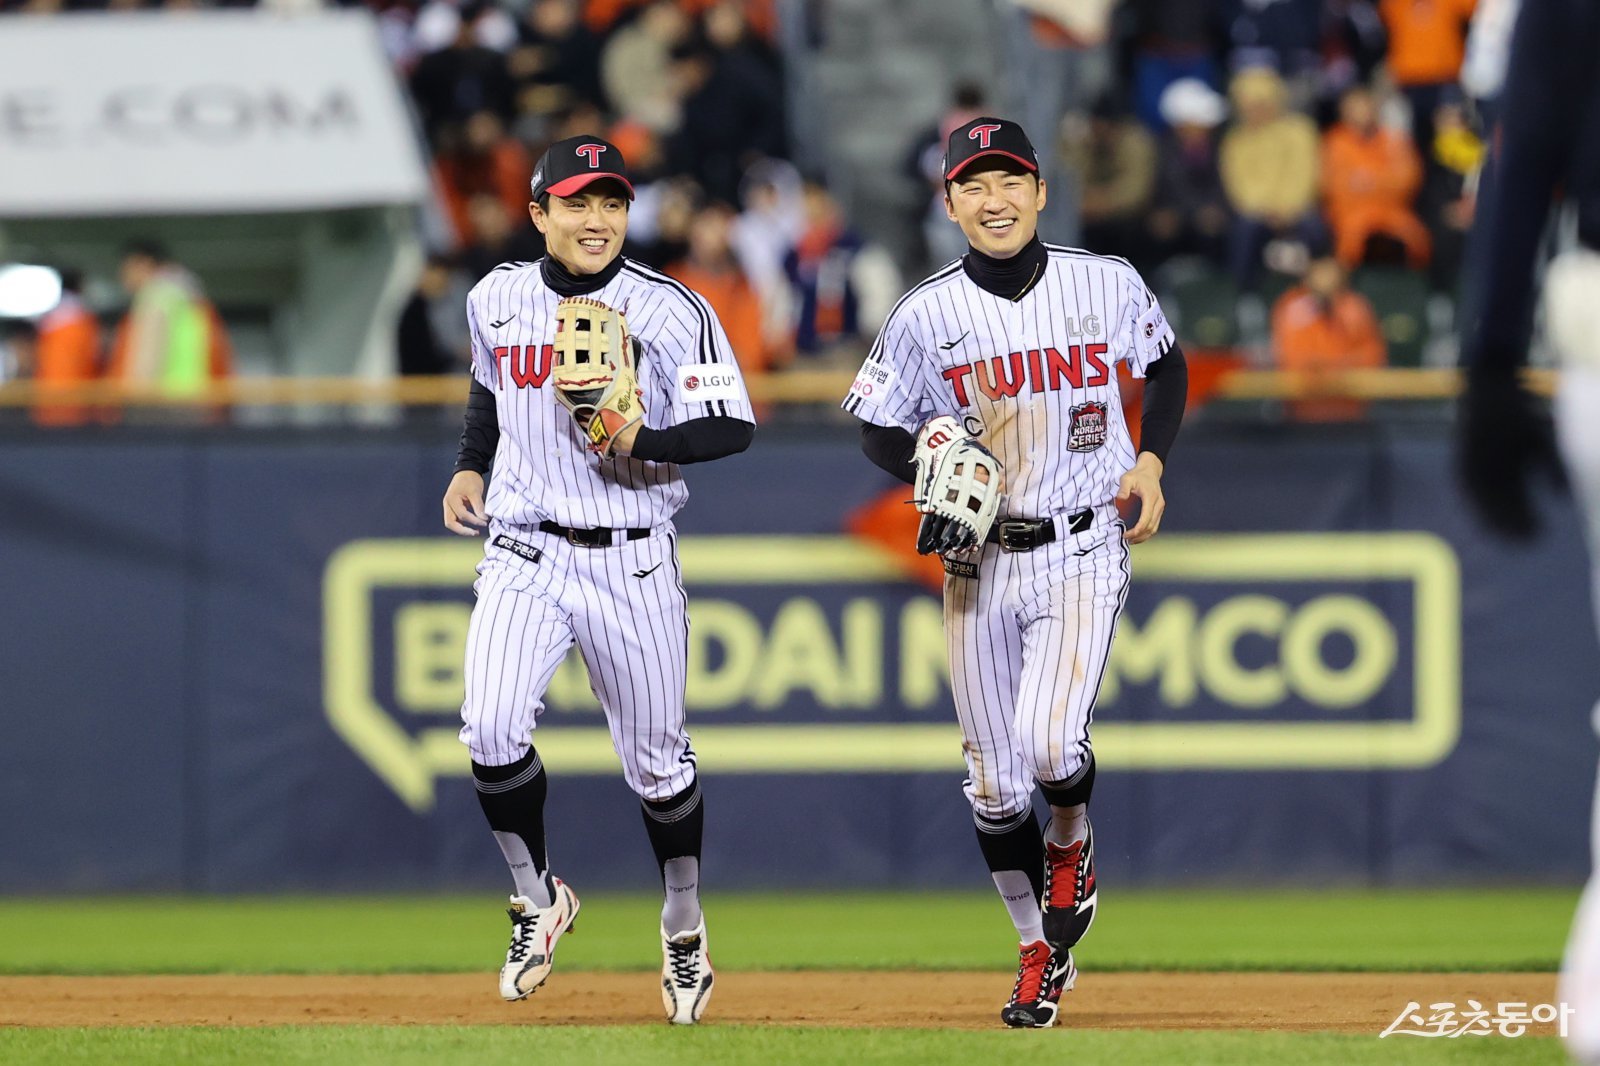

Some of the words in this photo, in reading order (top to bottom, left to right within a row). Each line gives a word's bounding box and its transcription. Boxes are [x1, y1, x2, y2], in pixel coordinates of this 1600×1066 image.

[968, 124, 1001, 148] T
[576, 144, 607, 168] T
[1067, 315, 1100, 338] LG
[703, 376, 720, 387] LG
[942, 343, 1109, 407] TWINS
[1069, 431, 1107, 449] SERIES
[1073, 424, 1105, 437] KOREAN
